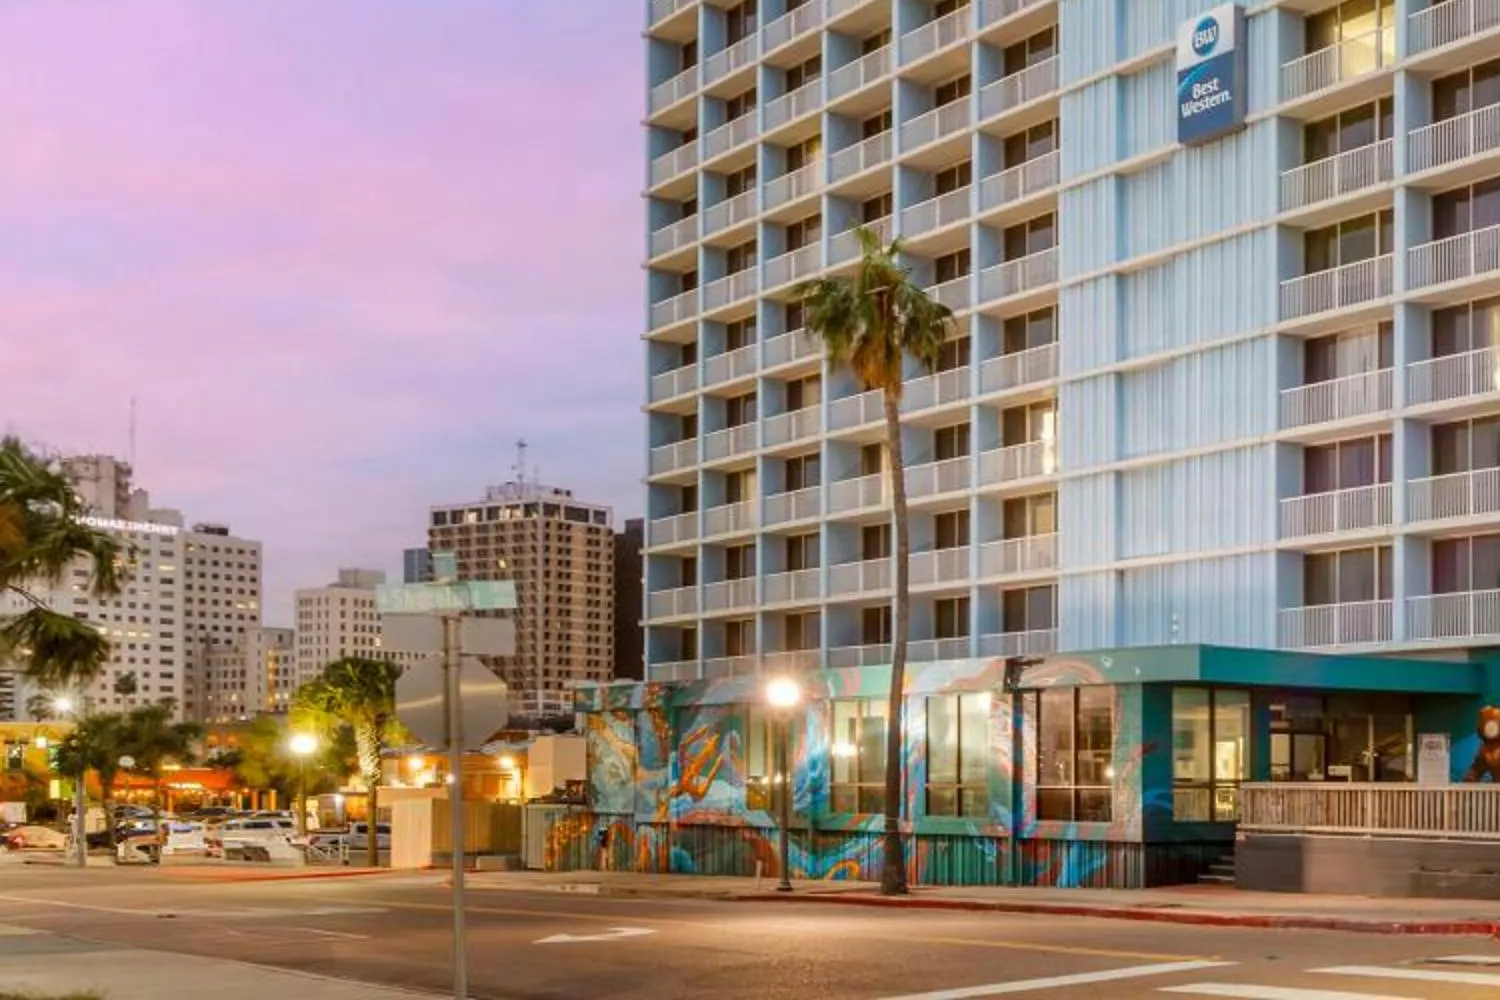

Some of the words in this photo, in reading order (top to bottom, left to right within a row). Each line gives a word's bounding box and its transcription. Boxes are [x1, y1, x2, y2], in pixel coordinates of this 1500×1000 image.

[1195, 26, 1217, 48] BW
[1192, 77, 1219, 99] Best
[1181, 89, 1229, 118] Western
